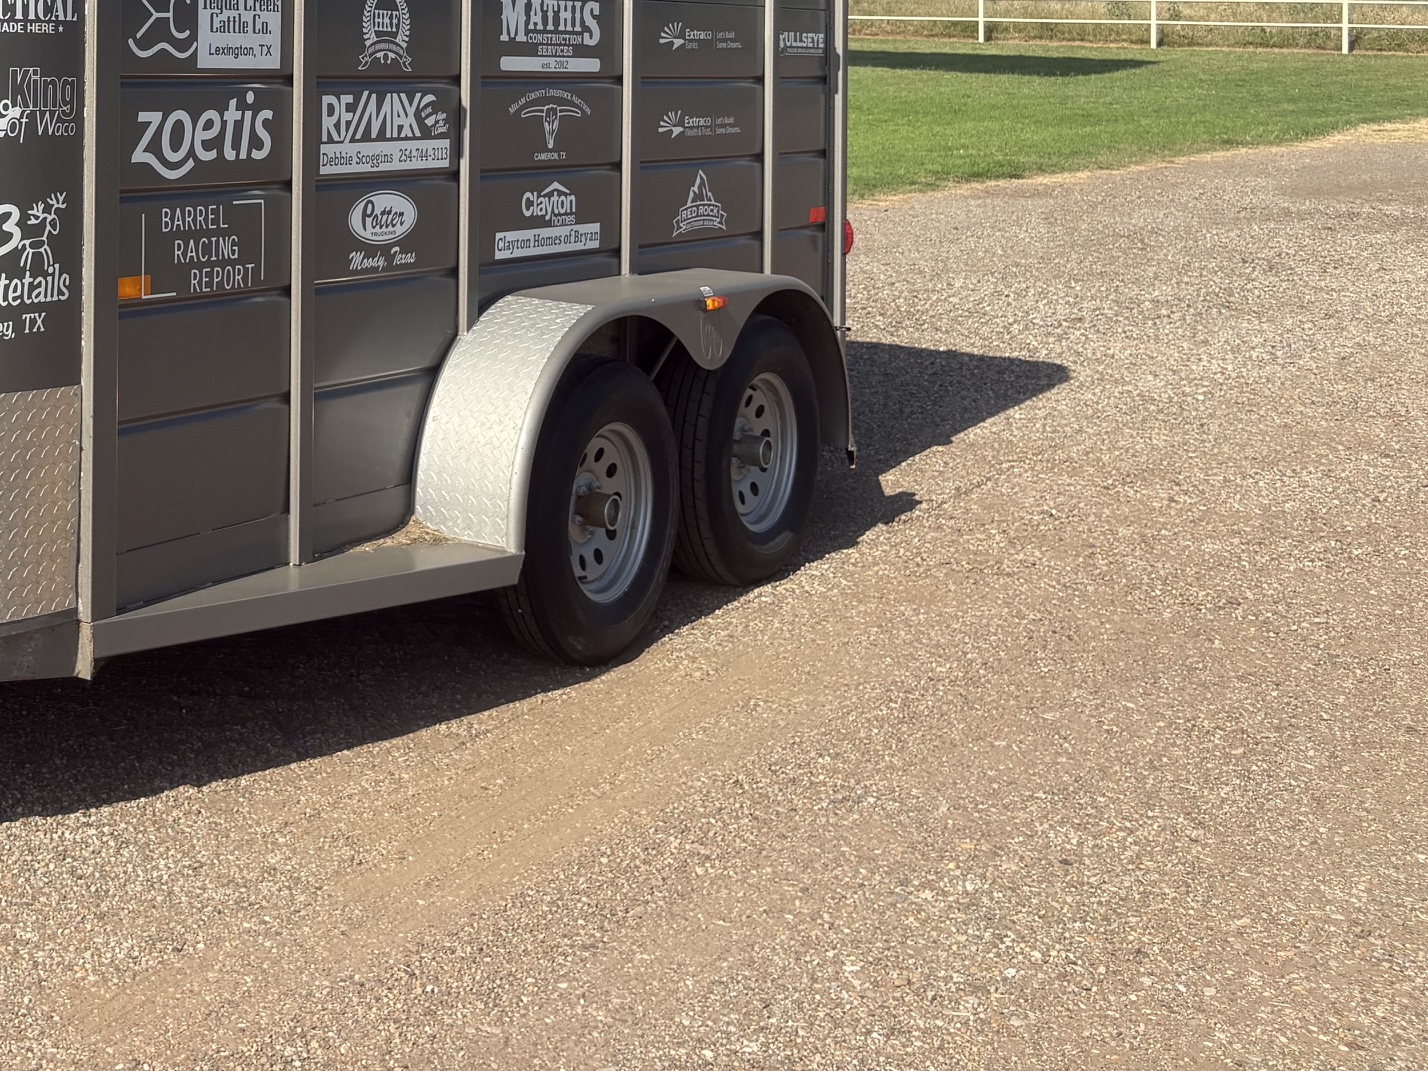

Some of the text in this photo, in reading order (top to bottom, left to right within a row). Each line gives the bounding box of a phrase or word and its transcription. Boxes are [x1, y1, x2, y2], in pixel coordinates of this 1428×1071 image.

[27, 22, 56, 34] HERE
[209, 12, 272, 35] Cattle Co.
[374, 9, 400, 32] HKF
[527, 33, 583, 45] CONSTRUCTION
[685, 28, 712, 40] Extraco
[208, 43, 272, 59] Lexington, TX
[537, 45, 573, 56] SERVICES
[541, 60, 569, 70] est. 2012
[9, 67, 77, 119] King
[6, 110, 76, 144] of Waco
[321, 90, 423, 144] RE/MAX
[684, 116, 712, 127] Extraco
[131, 90, 274, 181] zoetis
[321, 147, 449, 169] Debbie Scoggins 254-744-3113
[560, 152, 567, 160] TX
[361, 199, 406, 232] Potter
[521, 191, 576, 221] Clayton
[681, 205, 719, 221] RED ROCK
[161, 205, 229, 232] BARREL
[551, 214, 576, 226] homes
[370, 230, 397, 238] TRUCKING
[496, 229, 599, 255] Clayton Homes of Bryan
[174, 235, 239, 264] RACING
[349, 246, 416, 271] Moody, Texas
[190, 263, 255, 293] REPORT
[22, 312, 47, 334] TX
